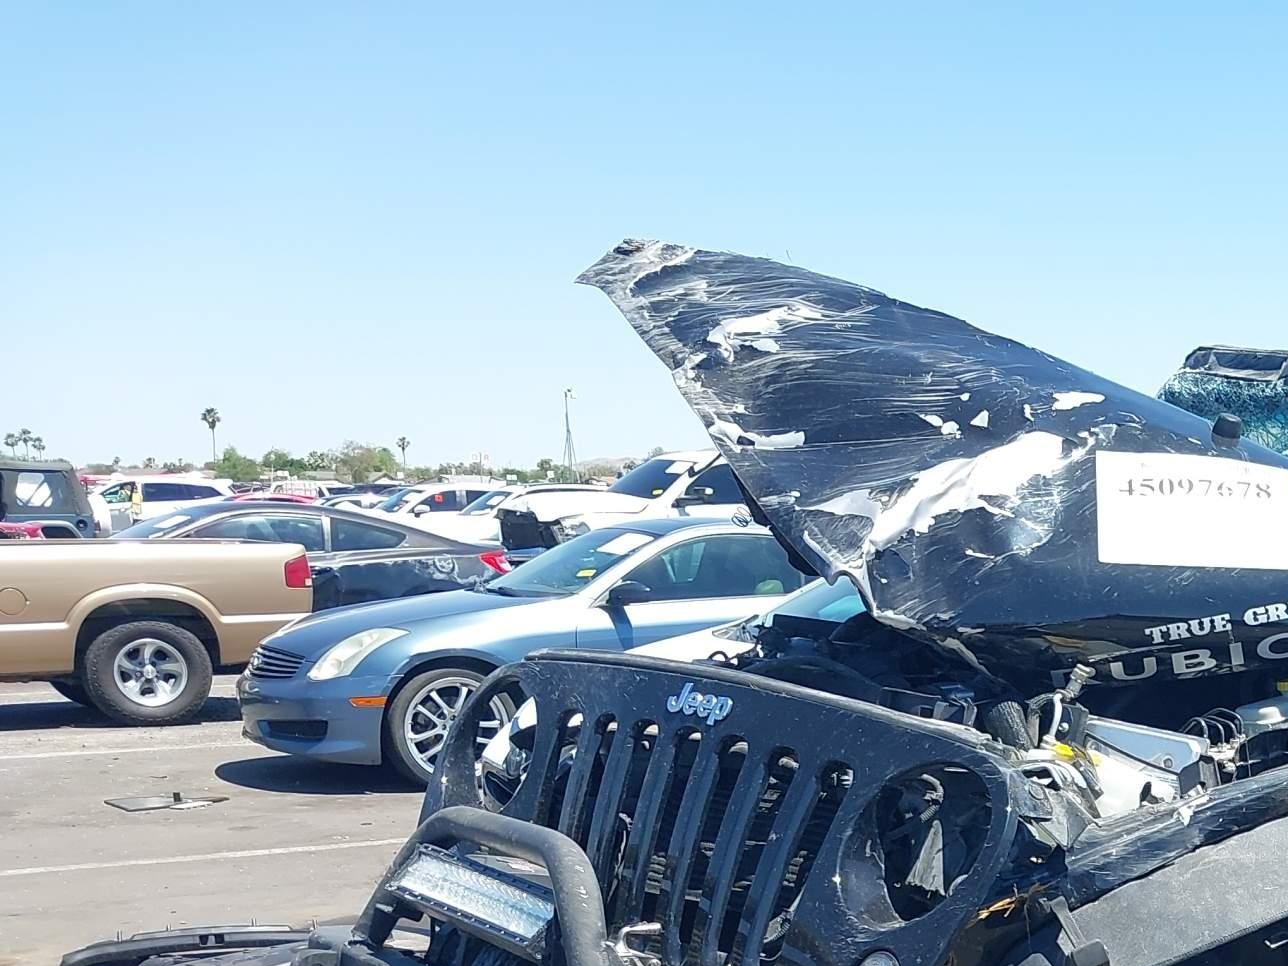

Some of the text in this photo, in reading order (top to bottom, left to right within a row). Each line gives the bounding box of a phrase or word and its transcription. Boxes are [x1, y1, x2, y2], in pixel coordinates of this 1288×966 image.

[1119, 477, 1273, 499] 45097678
[1144, 613, 1233, 645] TRUE
[666, 682, 734, 726] Jeep
